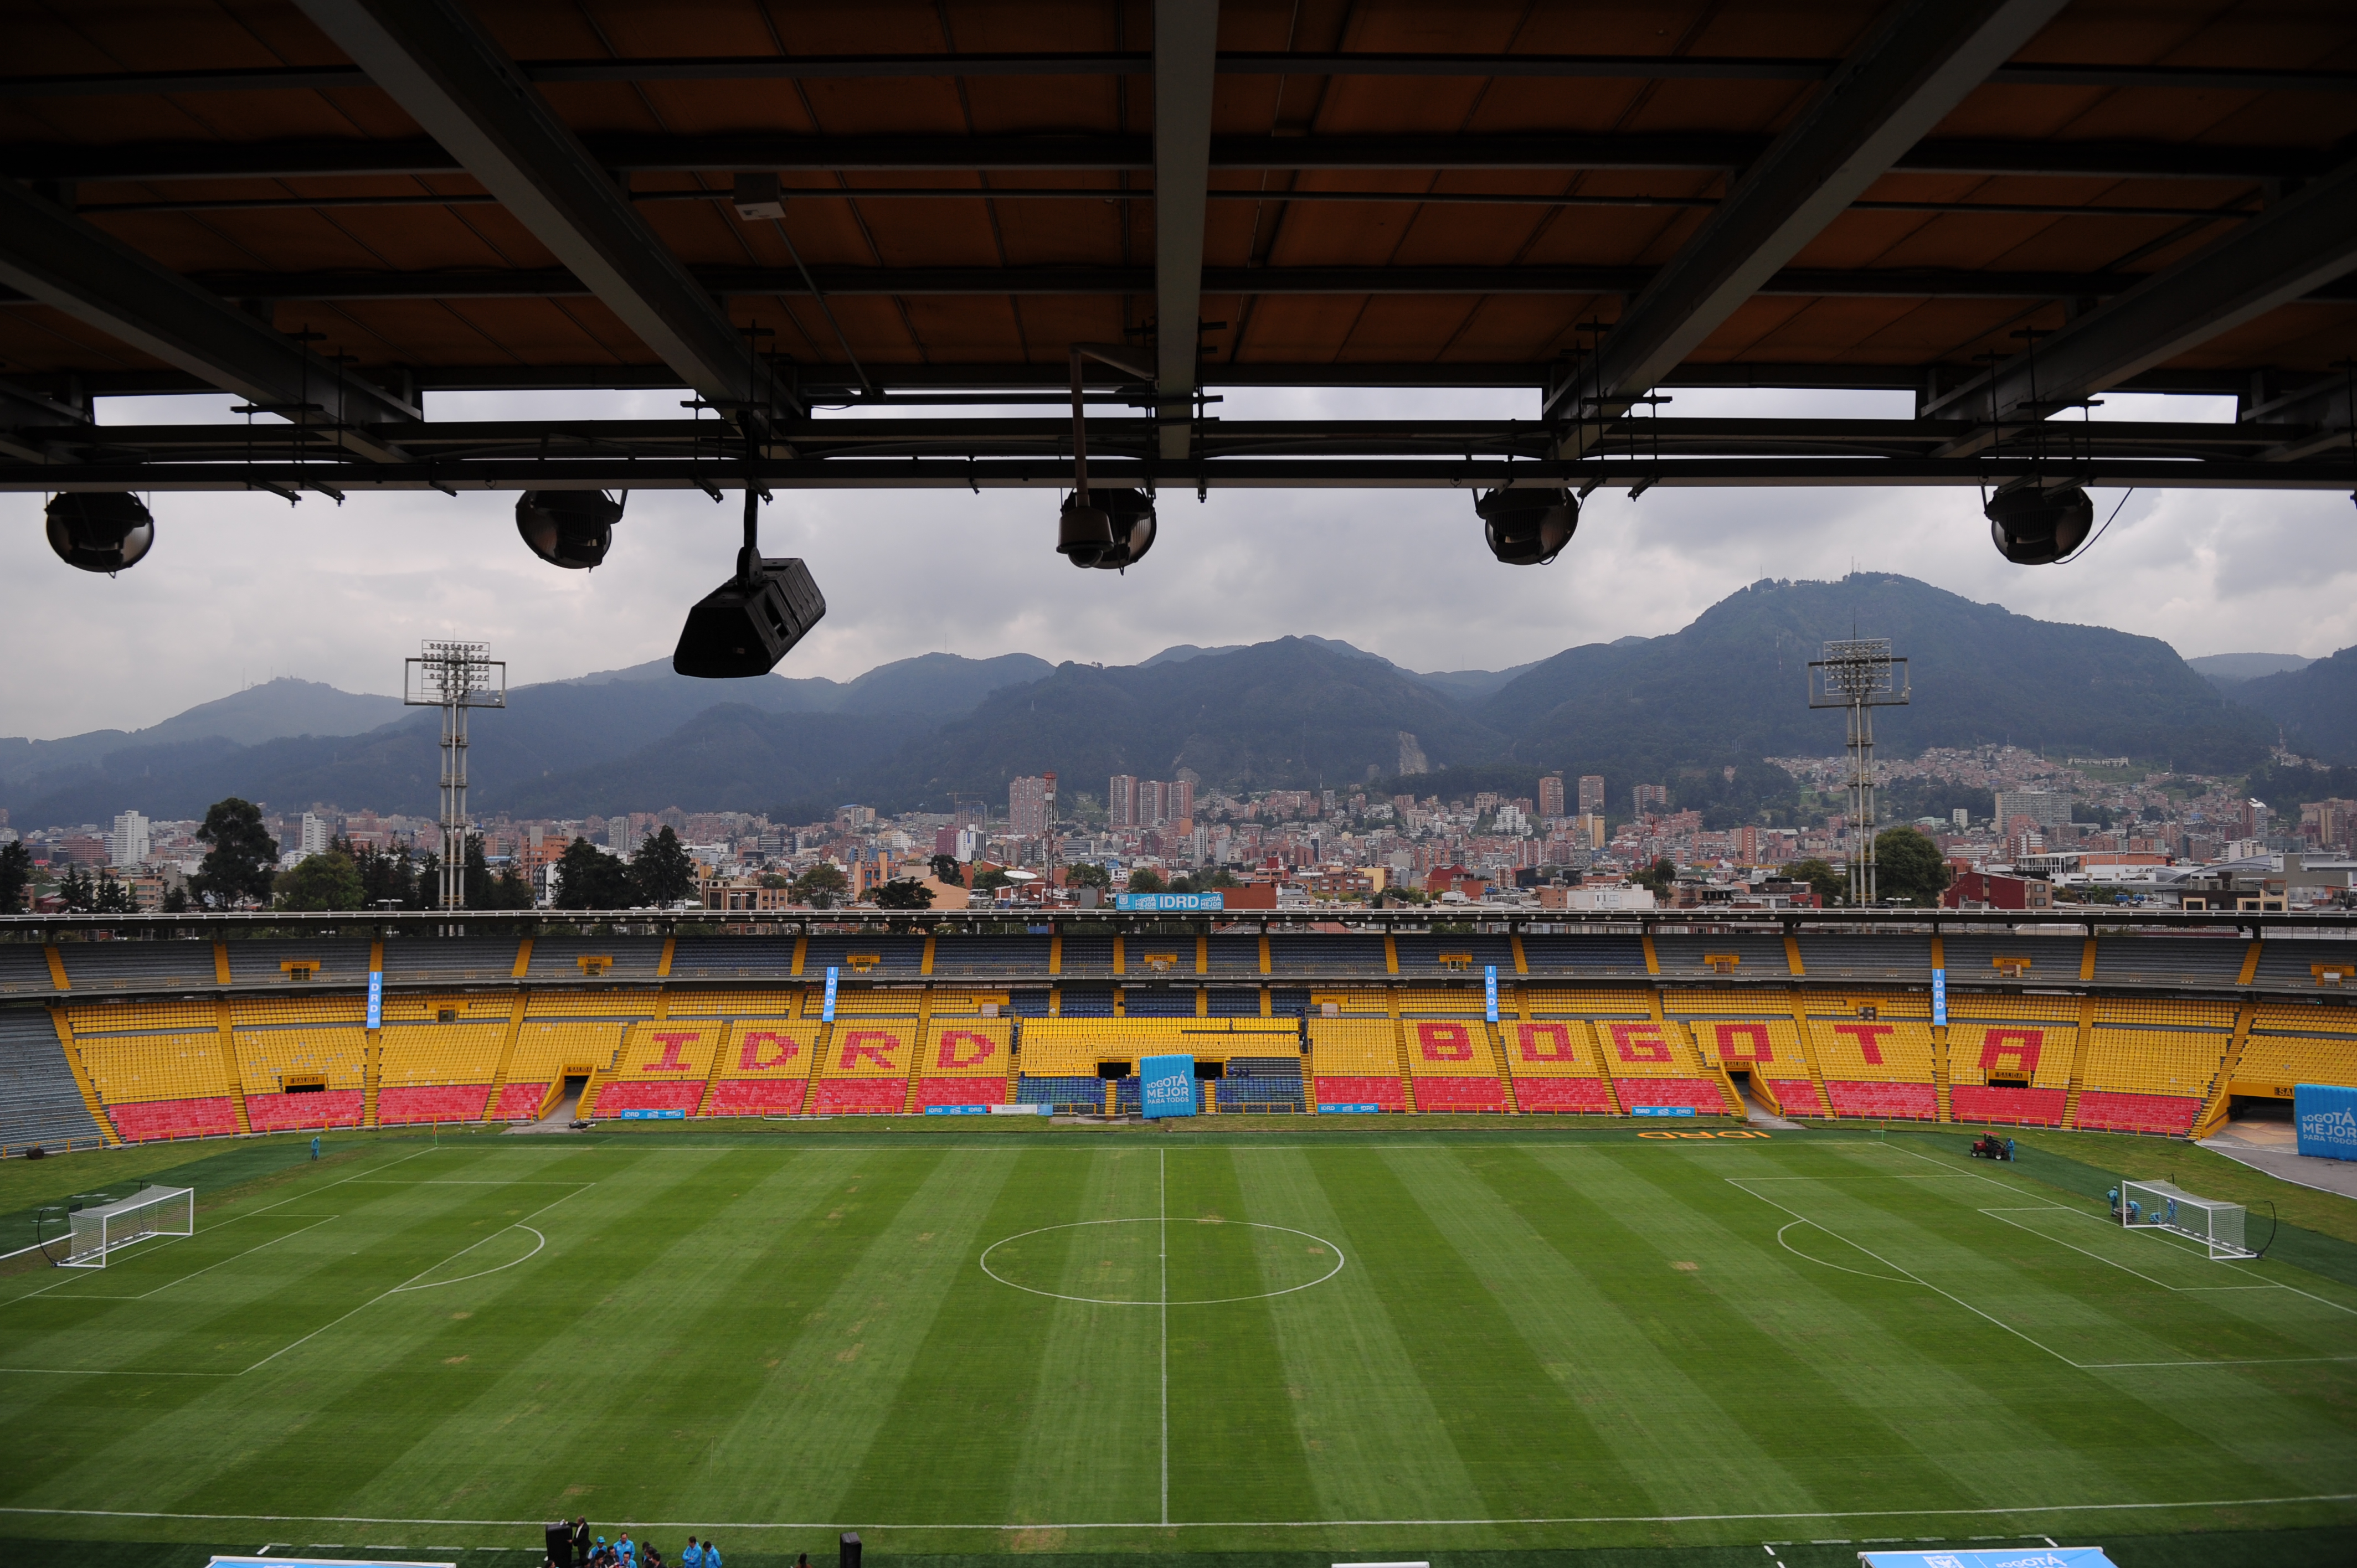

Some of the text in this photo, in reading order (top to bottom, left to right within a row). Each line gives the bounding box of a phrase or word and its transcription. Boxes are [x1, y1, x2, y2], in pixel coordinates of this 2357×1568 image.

[1160, 896, 1199, 908] IDRD
[370, 972, 379, 1013] IDRD
[826, 967, 835, 1006] IDRD
[1935, 969, 1944, 1009] IDRD
[1146, 1070, 1188, 1089] BOGOTÁ
[1147, 1087, 1189, 1098] MEJOR
[2302, 1107, 2356, 1127] BOGOTÁ
[2303, 1123, 2357, 1138] MEJOR
[2327, 1136, 2357, 1145] TODOS
[1995, 1553, 2067, 1567] BOGOTÁ
